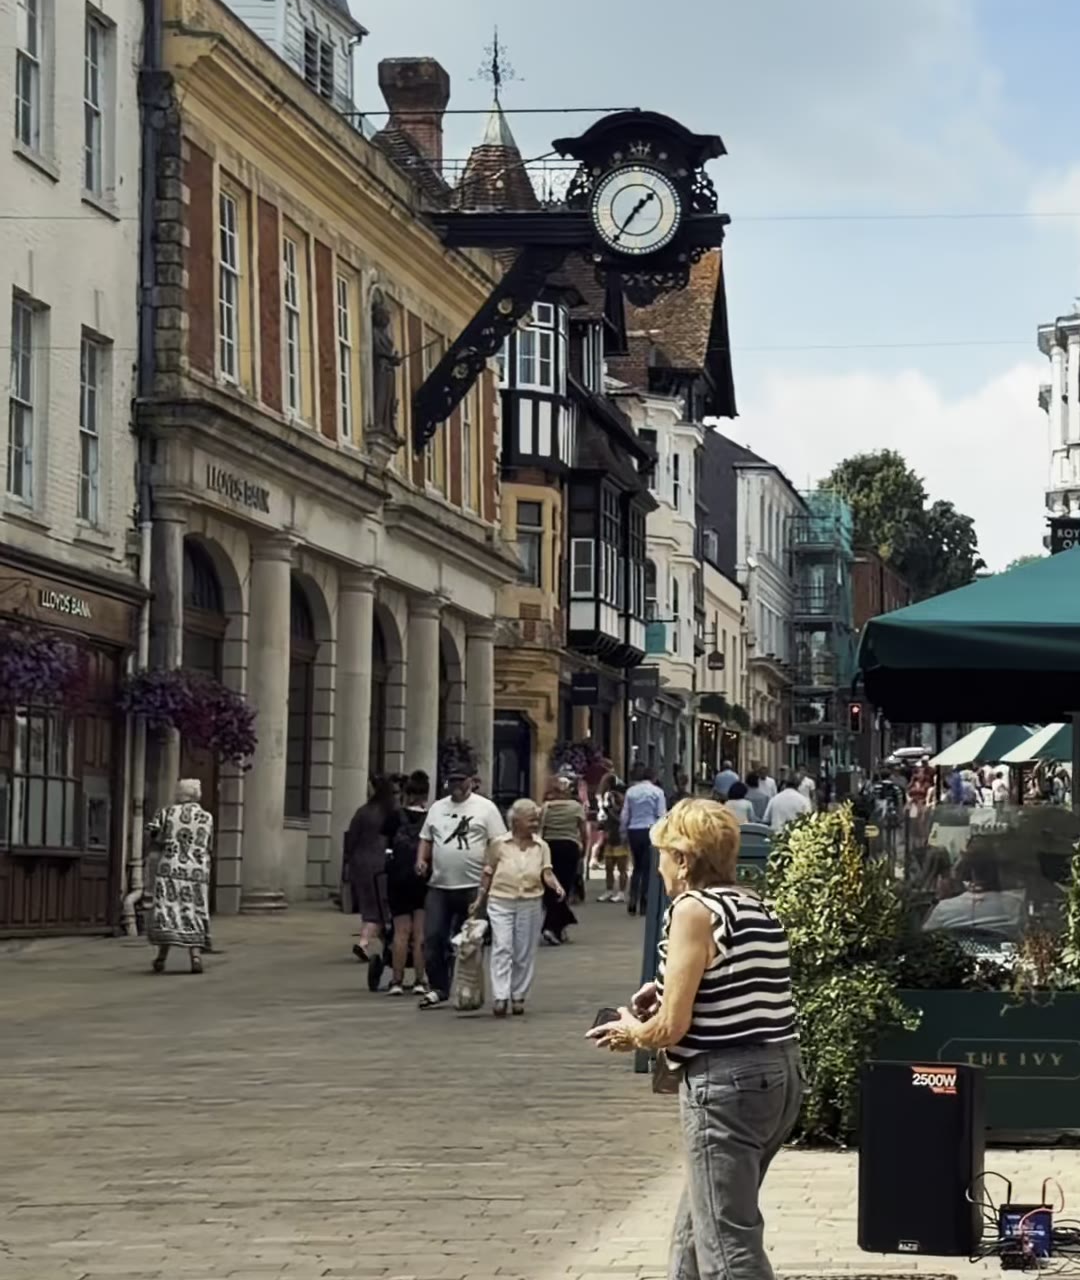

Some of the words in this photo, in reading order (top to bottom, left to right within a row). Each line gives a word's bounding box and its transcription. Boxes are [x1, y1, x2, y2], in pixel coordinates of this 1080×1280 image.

[206, 463, 243, 502] LLOYDS
[243, 480, 270, 514] BANK
[42, 589, 71, 613] LLOYDS
[71, 596, 92, 619] BANK
[965, 1051, 1008, 1067] THE
[1019, 1051, 1064, 1067] IVY
[911, 1072, 957, 1087] 2500W
